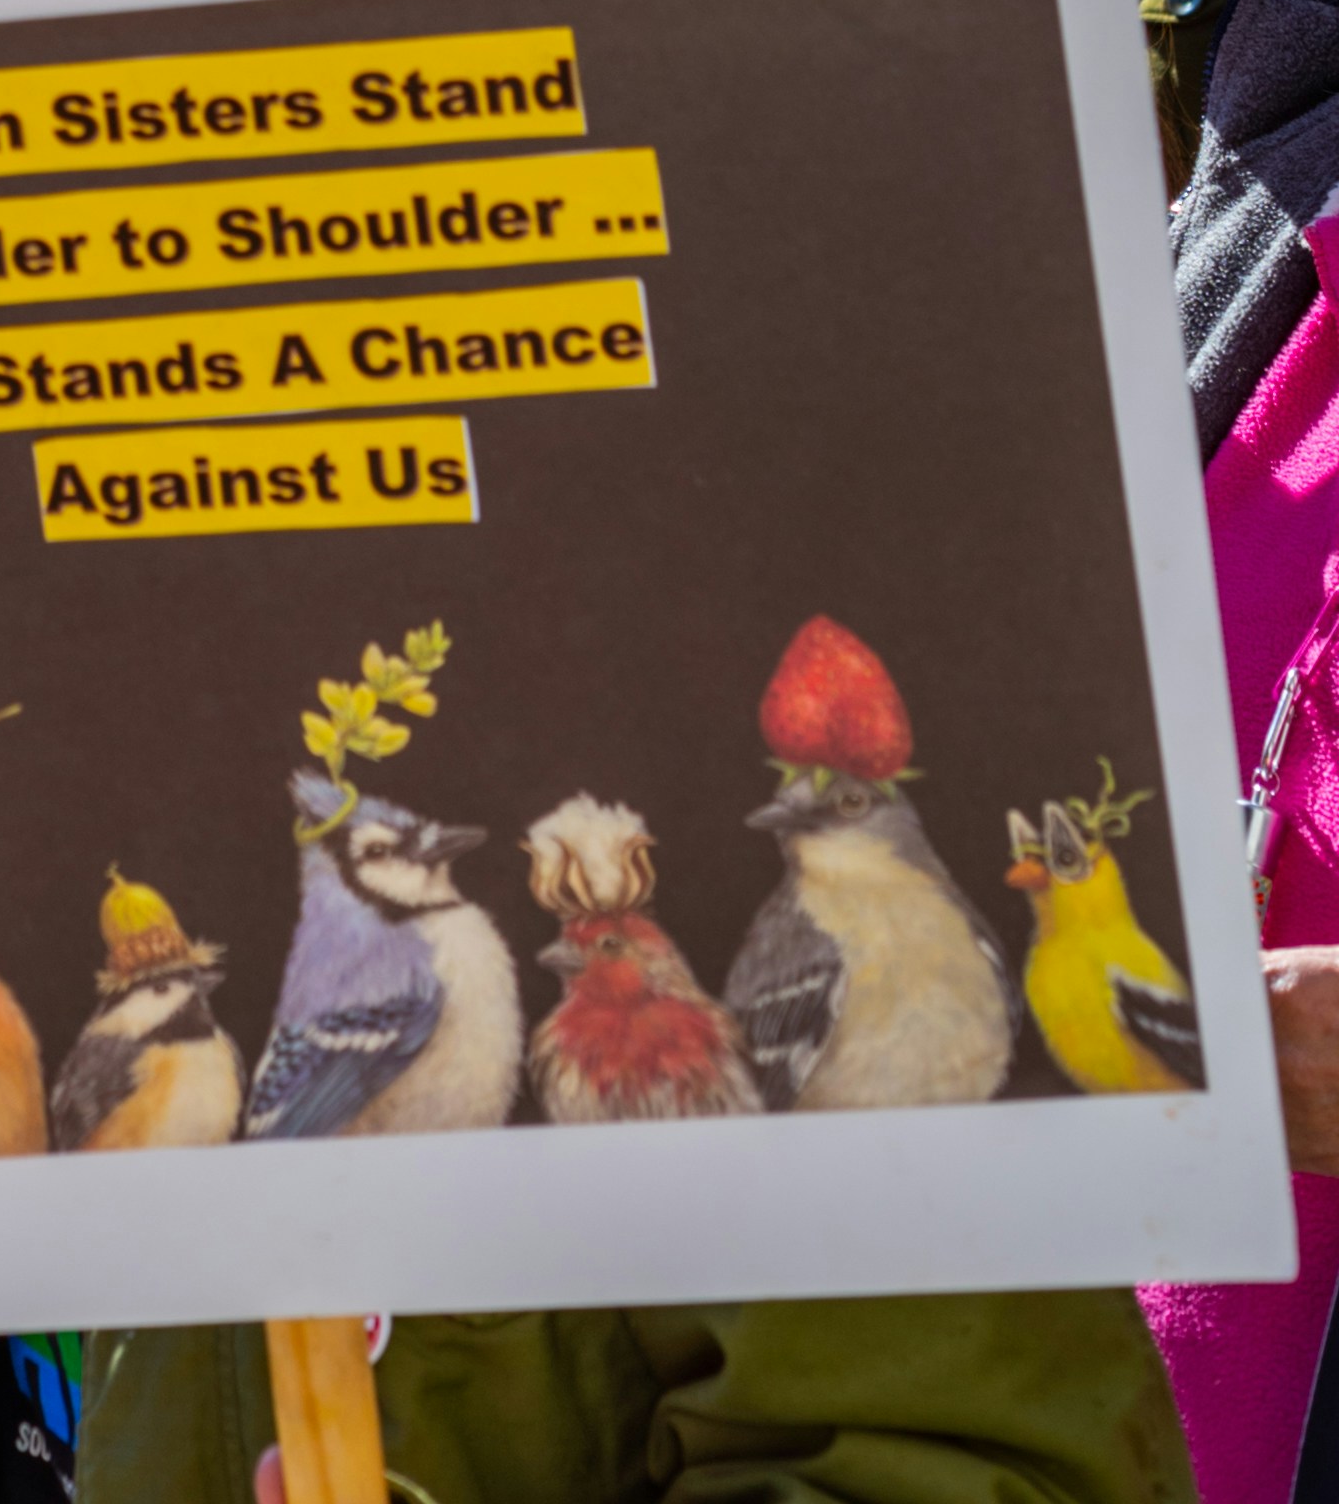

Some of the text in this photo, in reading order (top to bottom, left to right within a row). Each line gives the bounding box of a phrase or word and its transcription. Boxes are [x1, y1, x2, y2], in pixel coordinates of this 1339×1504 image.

[51, 87, 324, 147] Sisters
[350, 57, 578, 125] Stand
[111, 219, 190, 270] to
[216, 190, 565, 262] Shoulder
[271, 333, 326, 387] A
[349, 321, 645, 380] Chance
[45, 446, 468, 527] Against Us
